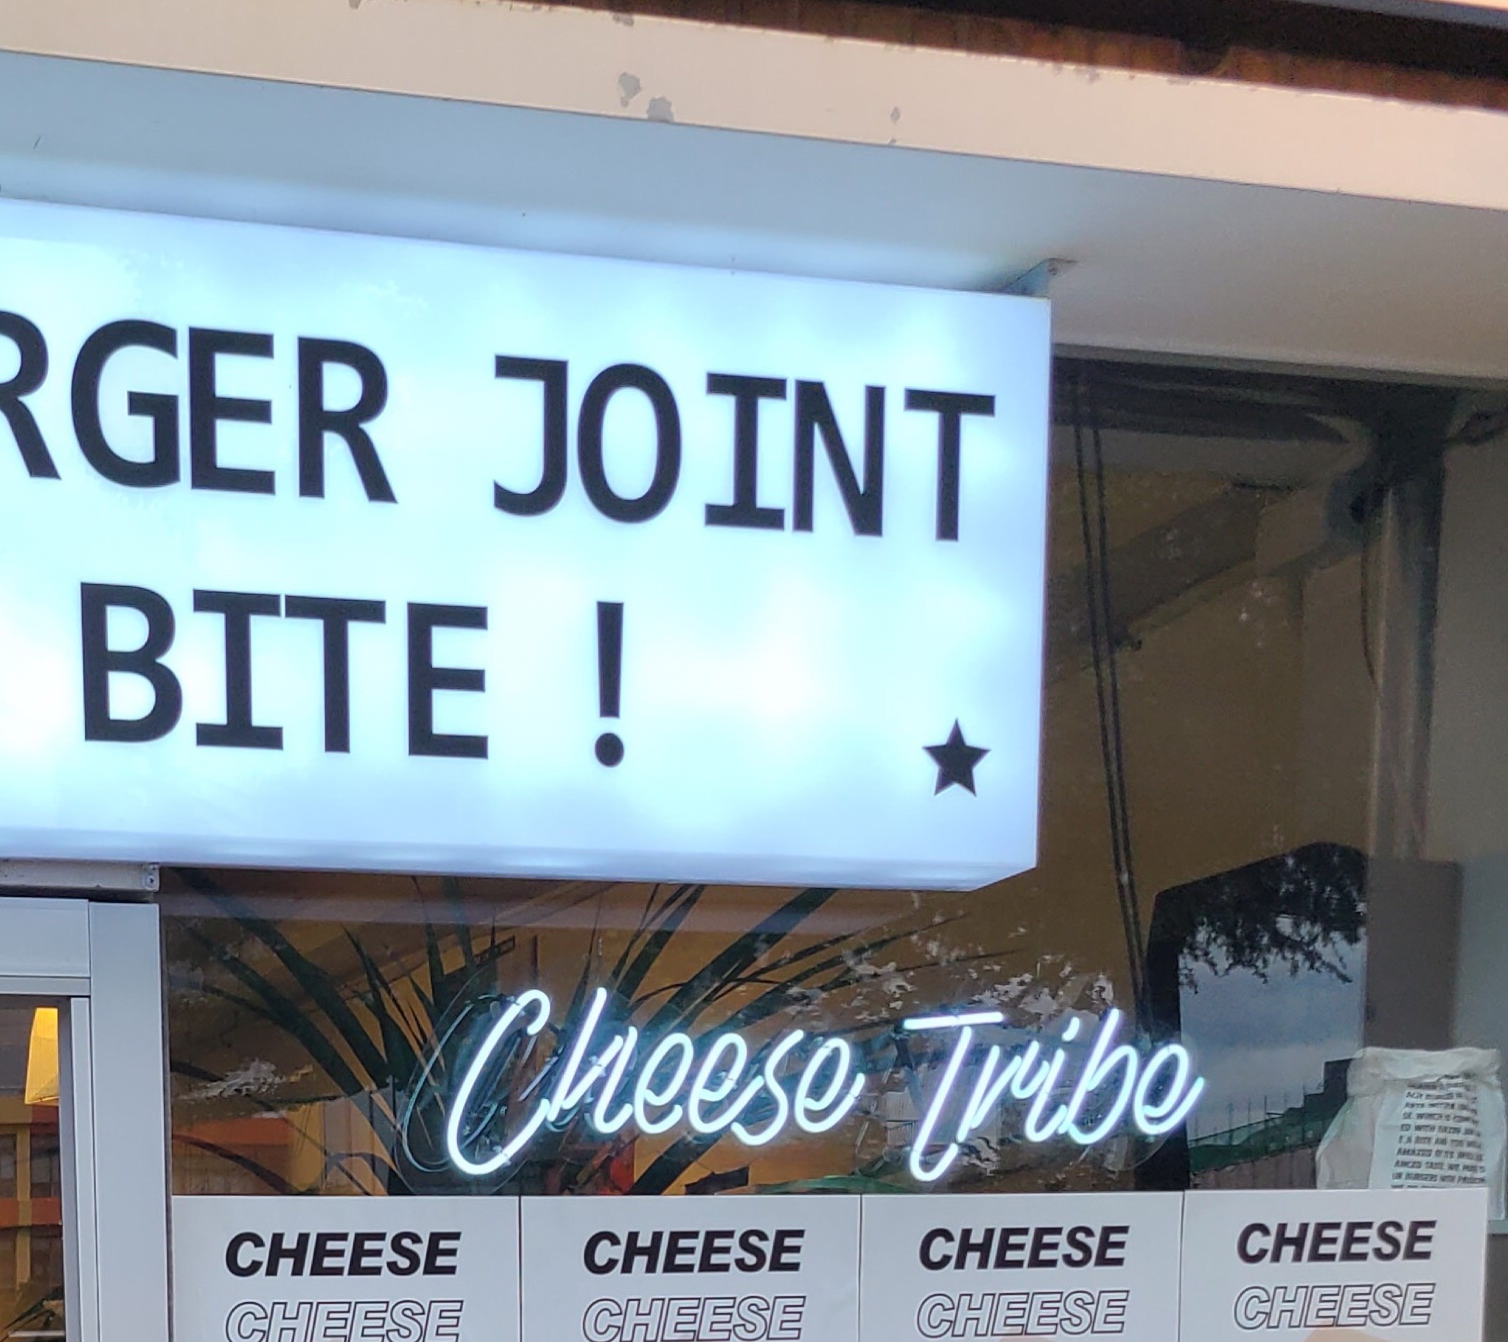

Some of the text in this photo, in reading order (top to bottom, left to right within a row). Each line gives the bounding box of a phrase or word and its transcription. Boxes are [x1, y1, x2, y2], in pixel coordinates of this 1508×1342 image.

[493, 354, 996, 542] JOINT
[81, 581, 488, 760] BITE
[592, 601, 626, 768] !
[447, 987, 1205, 1182] Cheese Tribe
[225, 1230, 462, 1277] CHEESE
[583, 1229, 806, 1275] CHEESE
[919, 1225, 1130, 1271] CHEESE
[1236, 1220, 1437, 1264] CHEESE
[917, 1290, 1130, 1339] CHEESE
[1234, 1282, 1436, 1330] CHEESE
